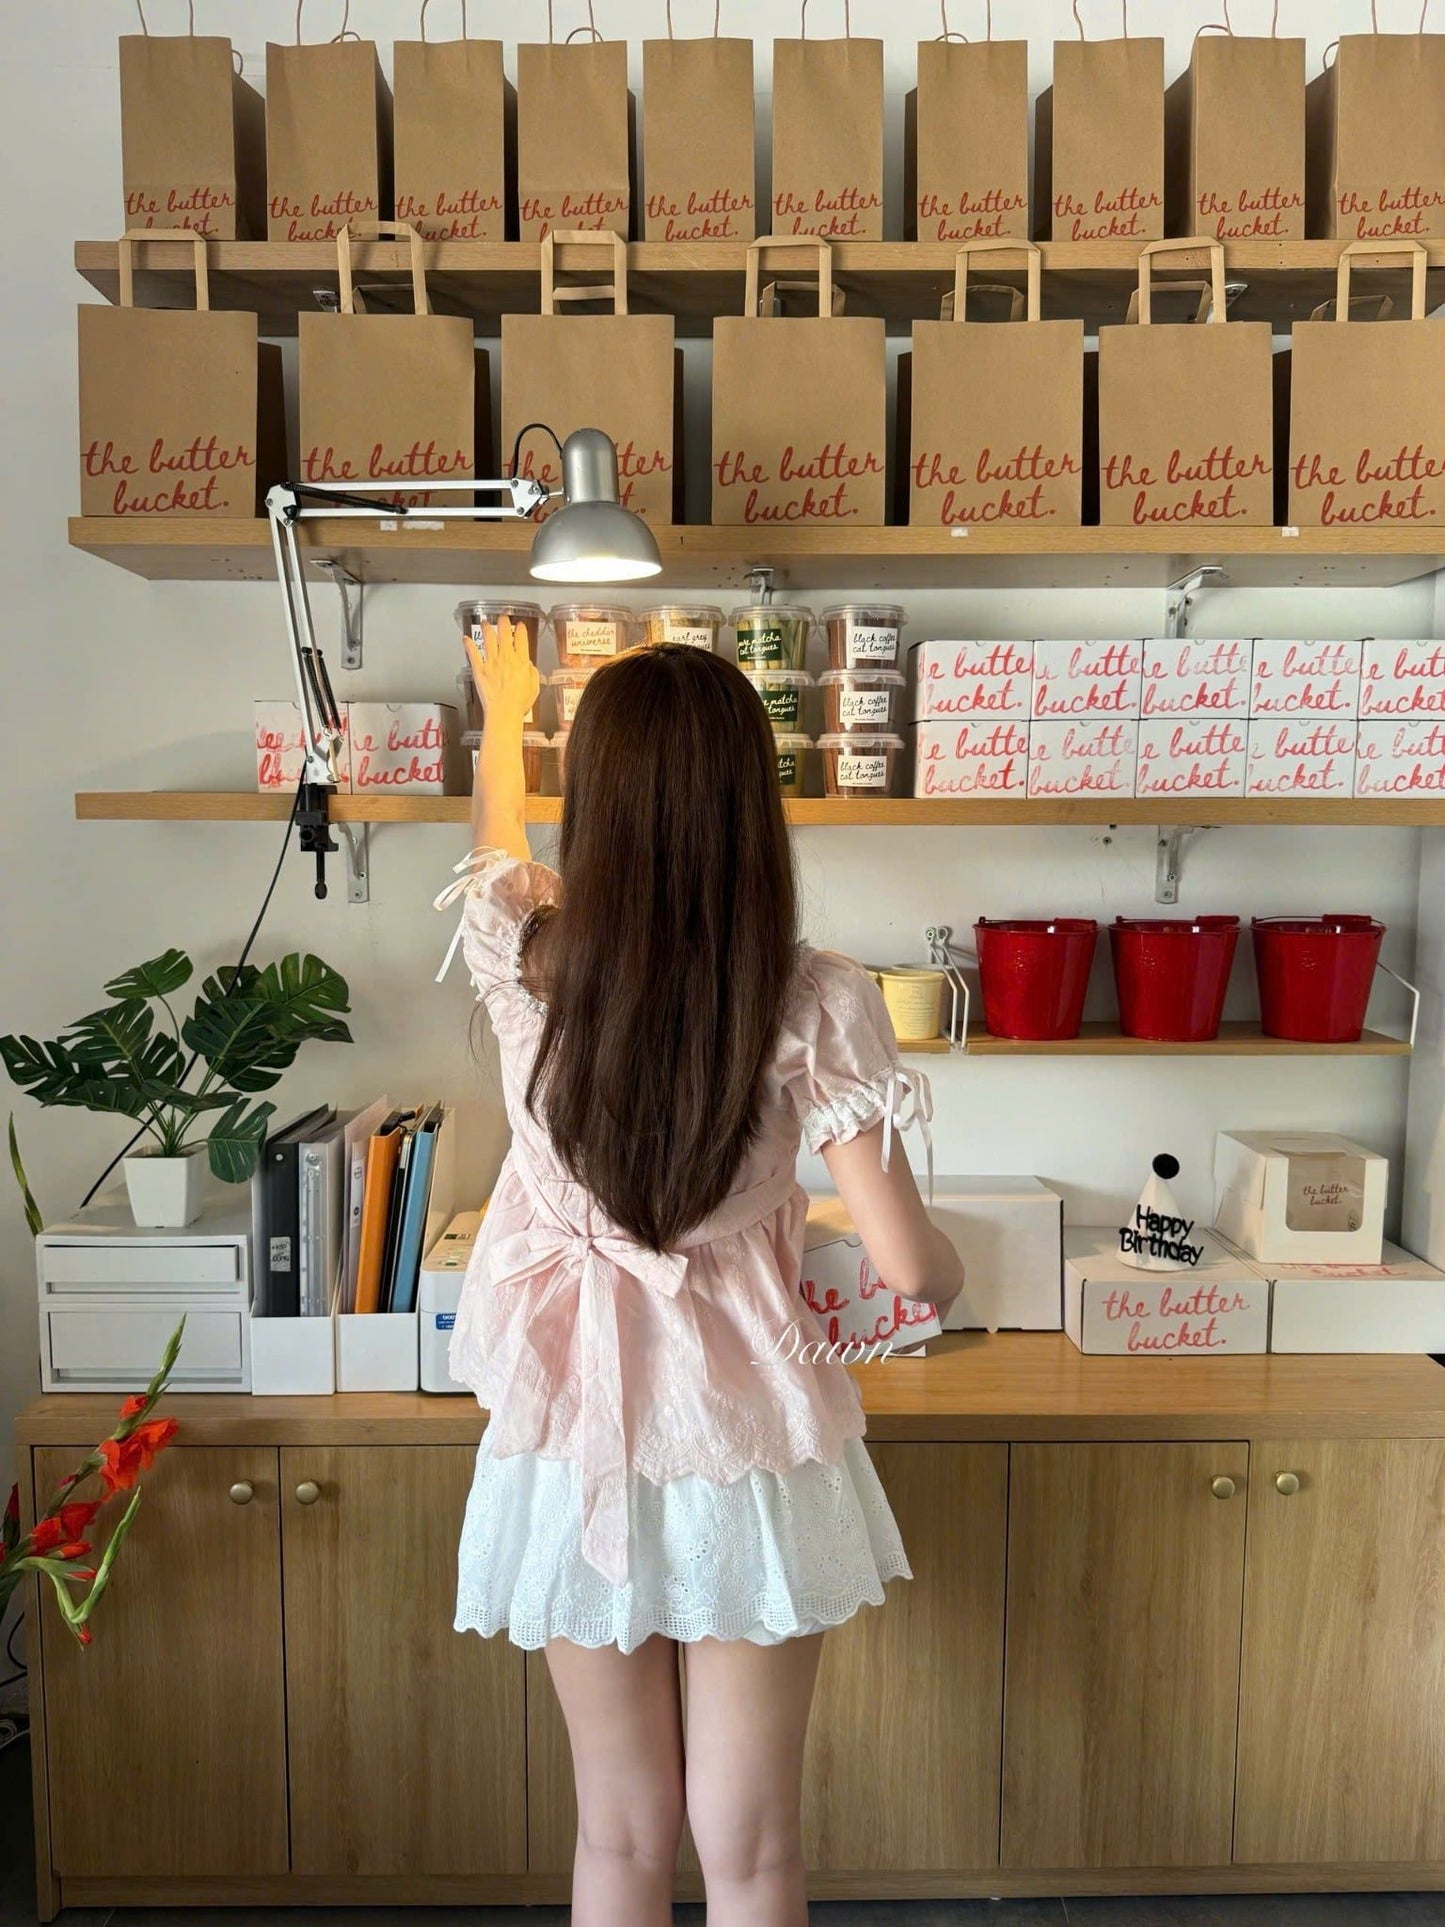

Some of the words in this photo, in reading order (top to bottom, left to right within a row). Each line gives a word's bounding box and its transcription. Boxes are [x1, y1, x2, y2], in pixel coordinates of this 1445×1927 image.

[125, 191, 162, 216] the
[167, 187, 235, 212] butter
[267, 193, 302, 219] the
[311, 190, 378, 216] butter
[396, 194, 433, 220] the
[436, 189, 503, 216] butter
[520, 196, 556, 222] the
[561, 193, 629, 216] butter
[647, 194, 682, 219] the
[687, 191, 755, 216] butter
[772, 192, 810, 217] the
[815, 188, 884, 213] butter
[918, 193, 955, 218] the
[960, 188, 1029, 213] butter
[1053, 193, 1091, 218] the
[1094, 188, 1164, 213] butter
[1198, 193, 1233, 218] the
[1237, 188, 1304, 213] butter
[1338, 193, 1375, 218] the
[1378, 186, 1445, 214] butter
[665, 216, 739, 243] bucket.
[790, 212, 867, 237] bucket.
[936, 214, 1013, 242] bucket.
[1070, 214, 1147, 242] bucket.
[1216, 214, 1290, 242] bucket.
[1356, 214, 1431, 239] bucket.
[80, 440, 144, 478] the
[149, 432, 255, 472] butter
[302, 447, 359, 483] the
[369, 440, 474, 478] butter
[713, 451, 770, 490] the
[777, 441, 886, 482] butter
[910, 451, 968, 490] the
[974, 443, 1083, 482] butter
[1101, 451, 1162, 490] the
[1169, 443, 1275, 482] butter
[1290, 451, 1351, 490] the
[1355, 443, 1445, 482] butte
[112, 475, 231, 516] bucket.
[743, 482, 859, 526] bucket.
[940, 482, 1058, 526] bucket.
[1131, 482, 1249, 526] bucket.
[1320, 482, 1439, 526] bucket.
[954, 644, 1033, 676] butte
[1033, 679, 1137, 717] bucket.
[1142, 677, 1247, 715] bucket.
[1274, 724, 1355, 758] butte
[925, 759, 1025, 795] bucket.
[1138, 758, 1240, 795] bucket.
[1136, 1204, 1195, 1240] Happy
[1120, 1226, 1206, 1267] Birthday
[1102, 1289, 1152, 1323] the
[1159, 1280, 1251, 1318] butter
[1126, 1317, 1228, 1353] bucket.
